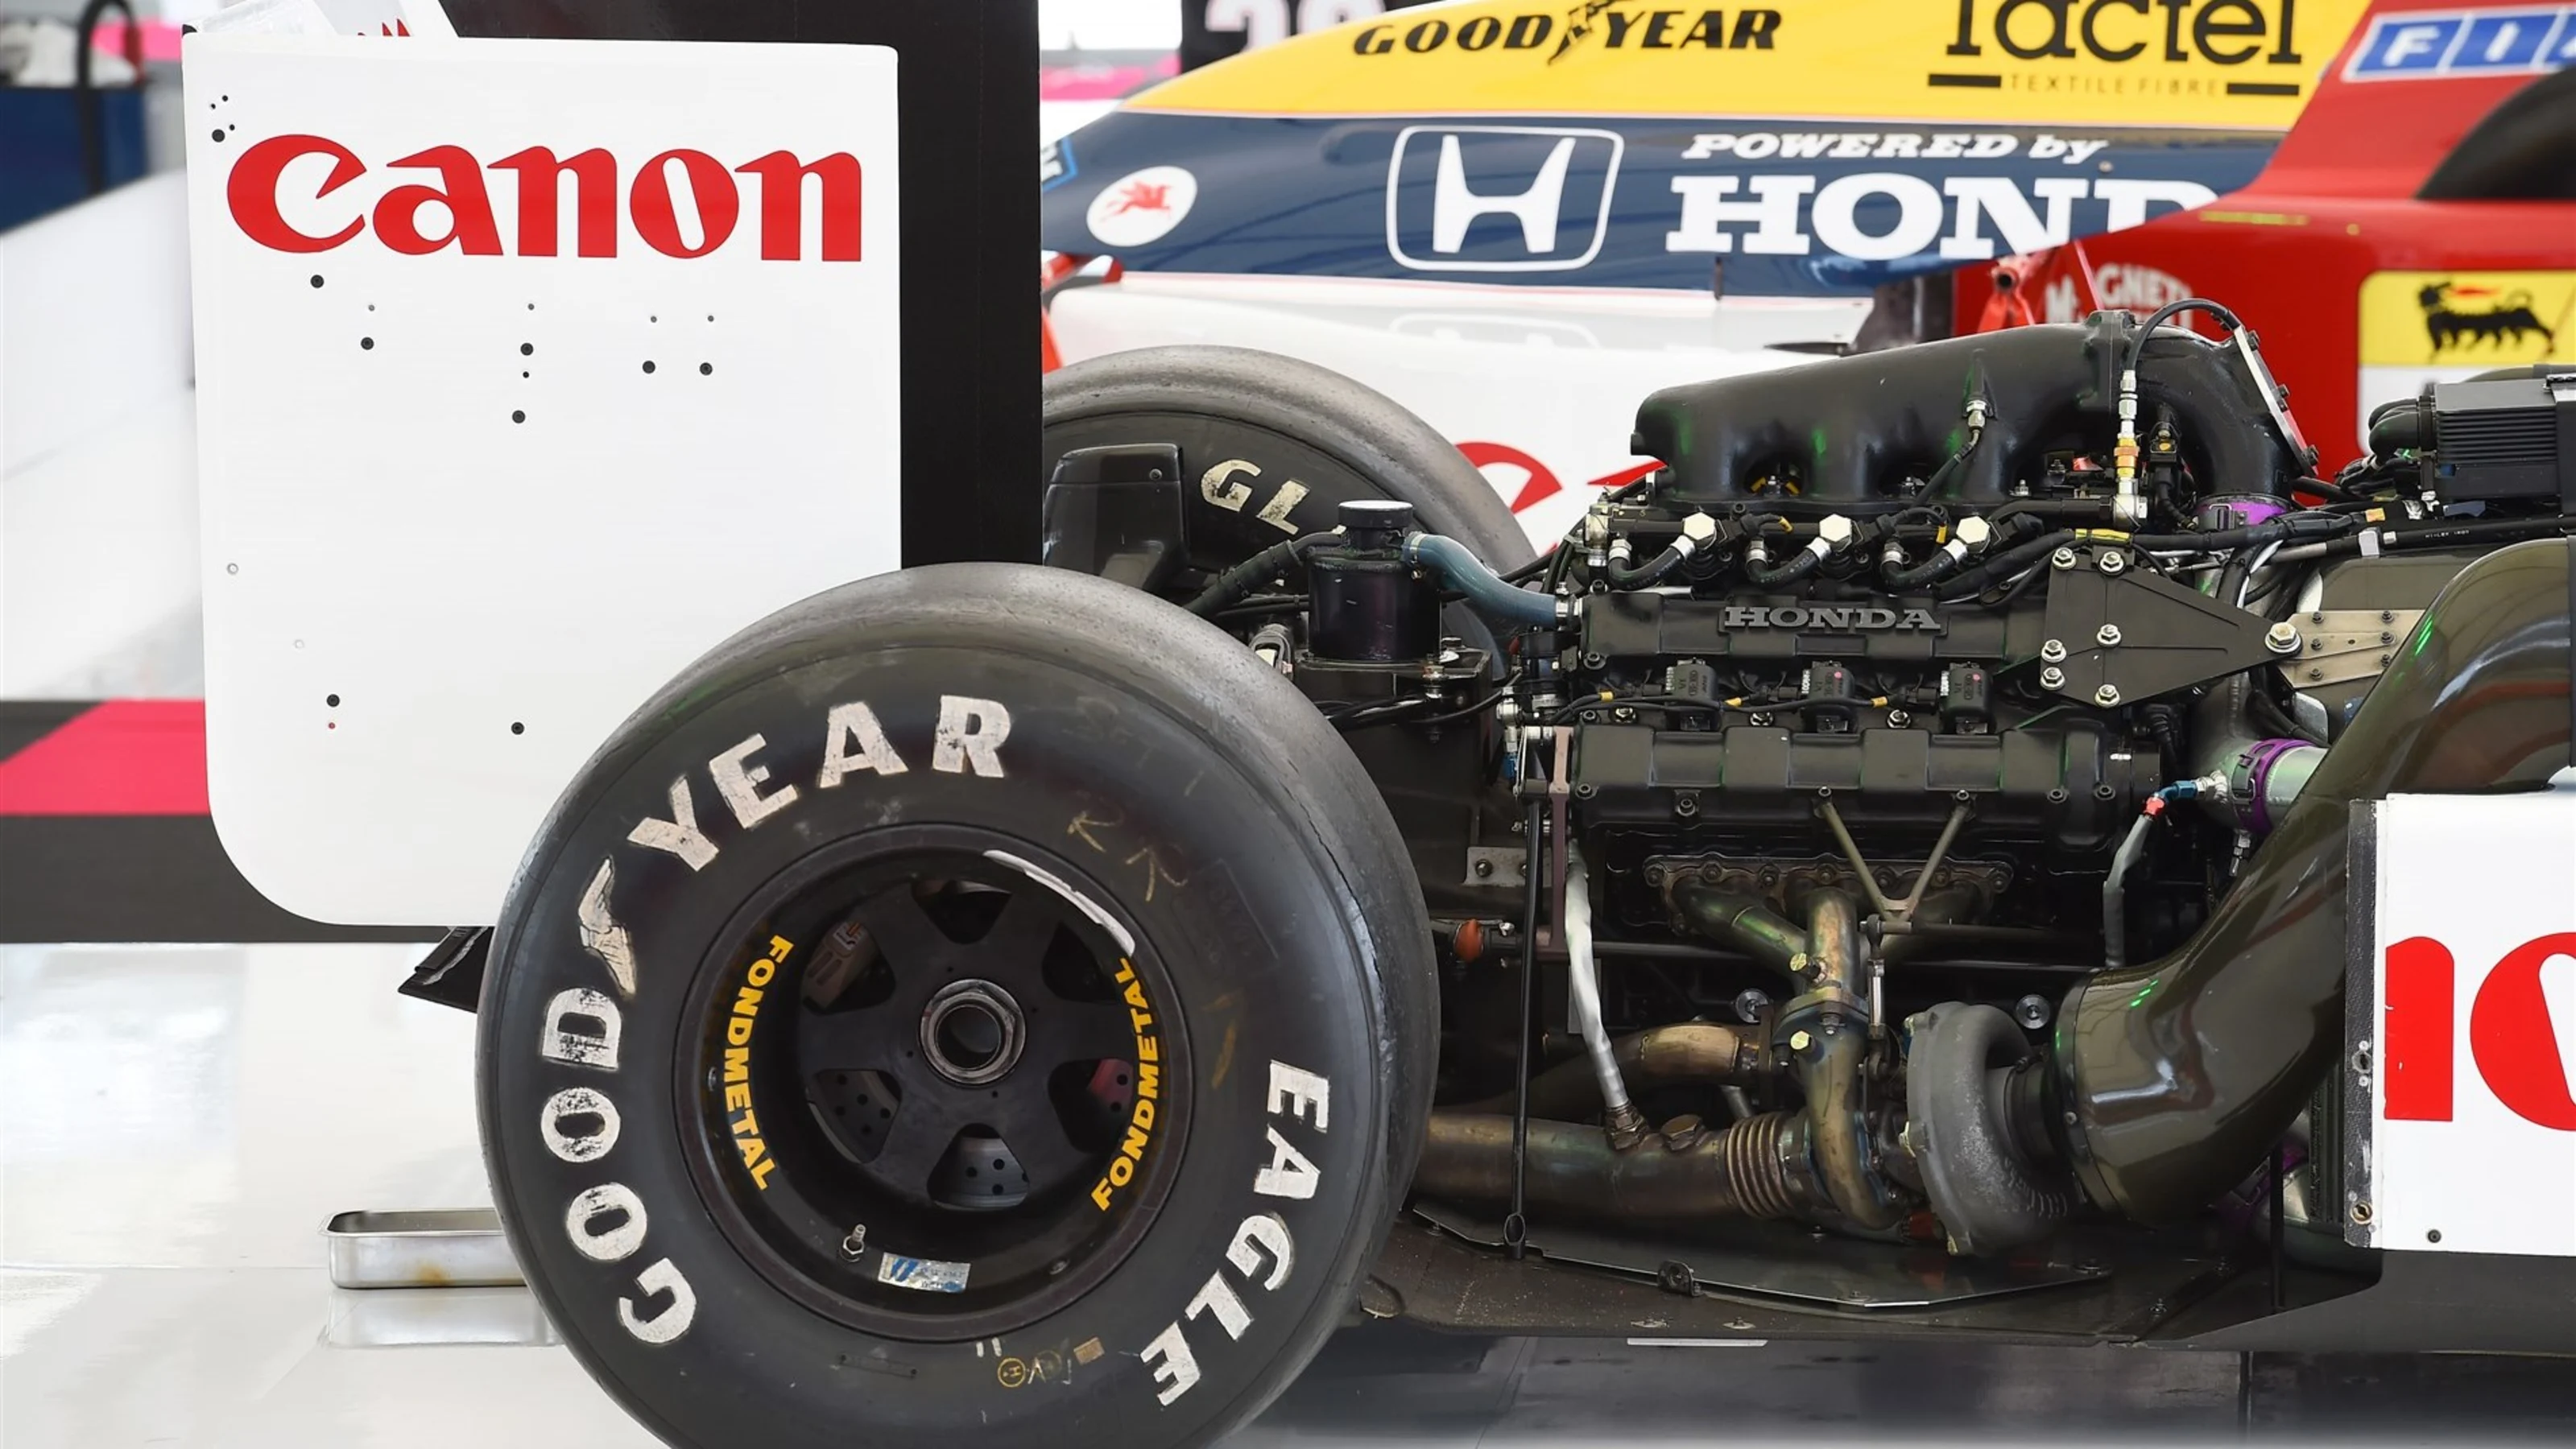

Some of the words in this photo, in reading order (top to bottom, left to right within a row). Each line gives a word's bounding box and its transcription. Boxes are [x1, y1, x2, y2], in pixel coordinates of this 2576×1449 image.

[1354, 13, 1553, 56] GOOD
[1602, 9, 1781, 50] YEAR
[2381, 21, 2576, 68] FI
[2011, 75, 2124, 93] TEXTILE
[2140, 79, 2218, 96] FIBRE
[1681, 133, 2018, 159] POWERED
[2029, 134, 2108, 164] by
[228, 134, 862, 262] Canon
[1725, 606, 1941, 630] HONDA
[540, 987, 697, 1344] GOOD
[626, 693, 1011, 872] YEAR
[724, 935, 793, 1189] FONDMETAL
[1092, 959, 1159, 1211] FONDMETAL
[1139, 1059, 1330, 1406] EAGLE
